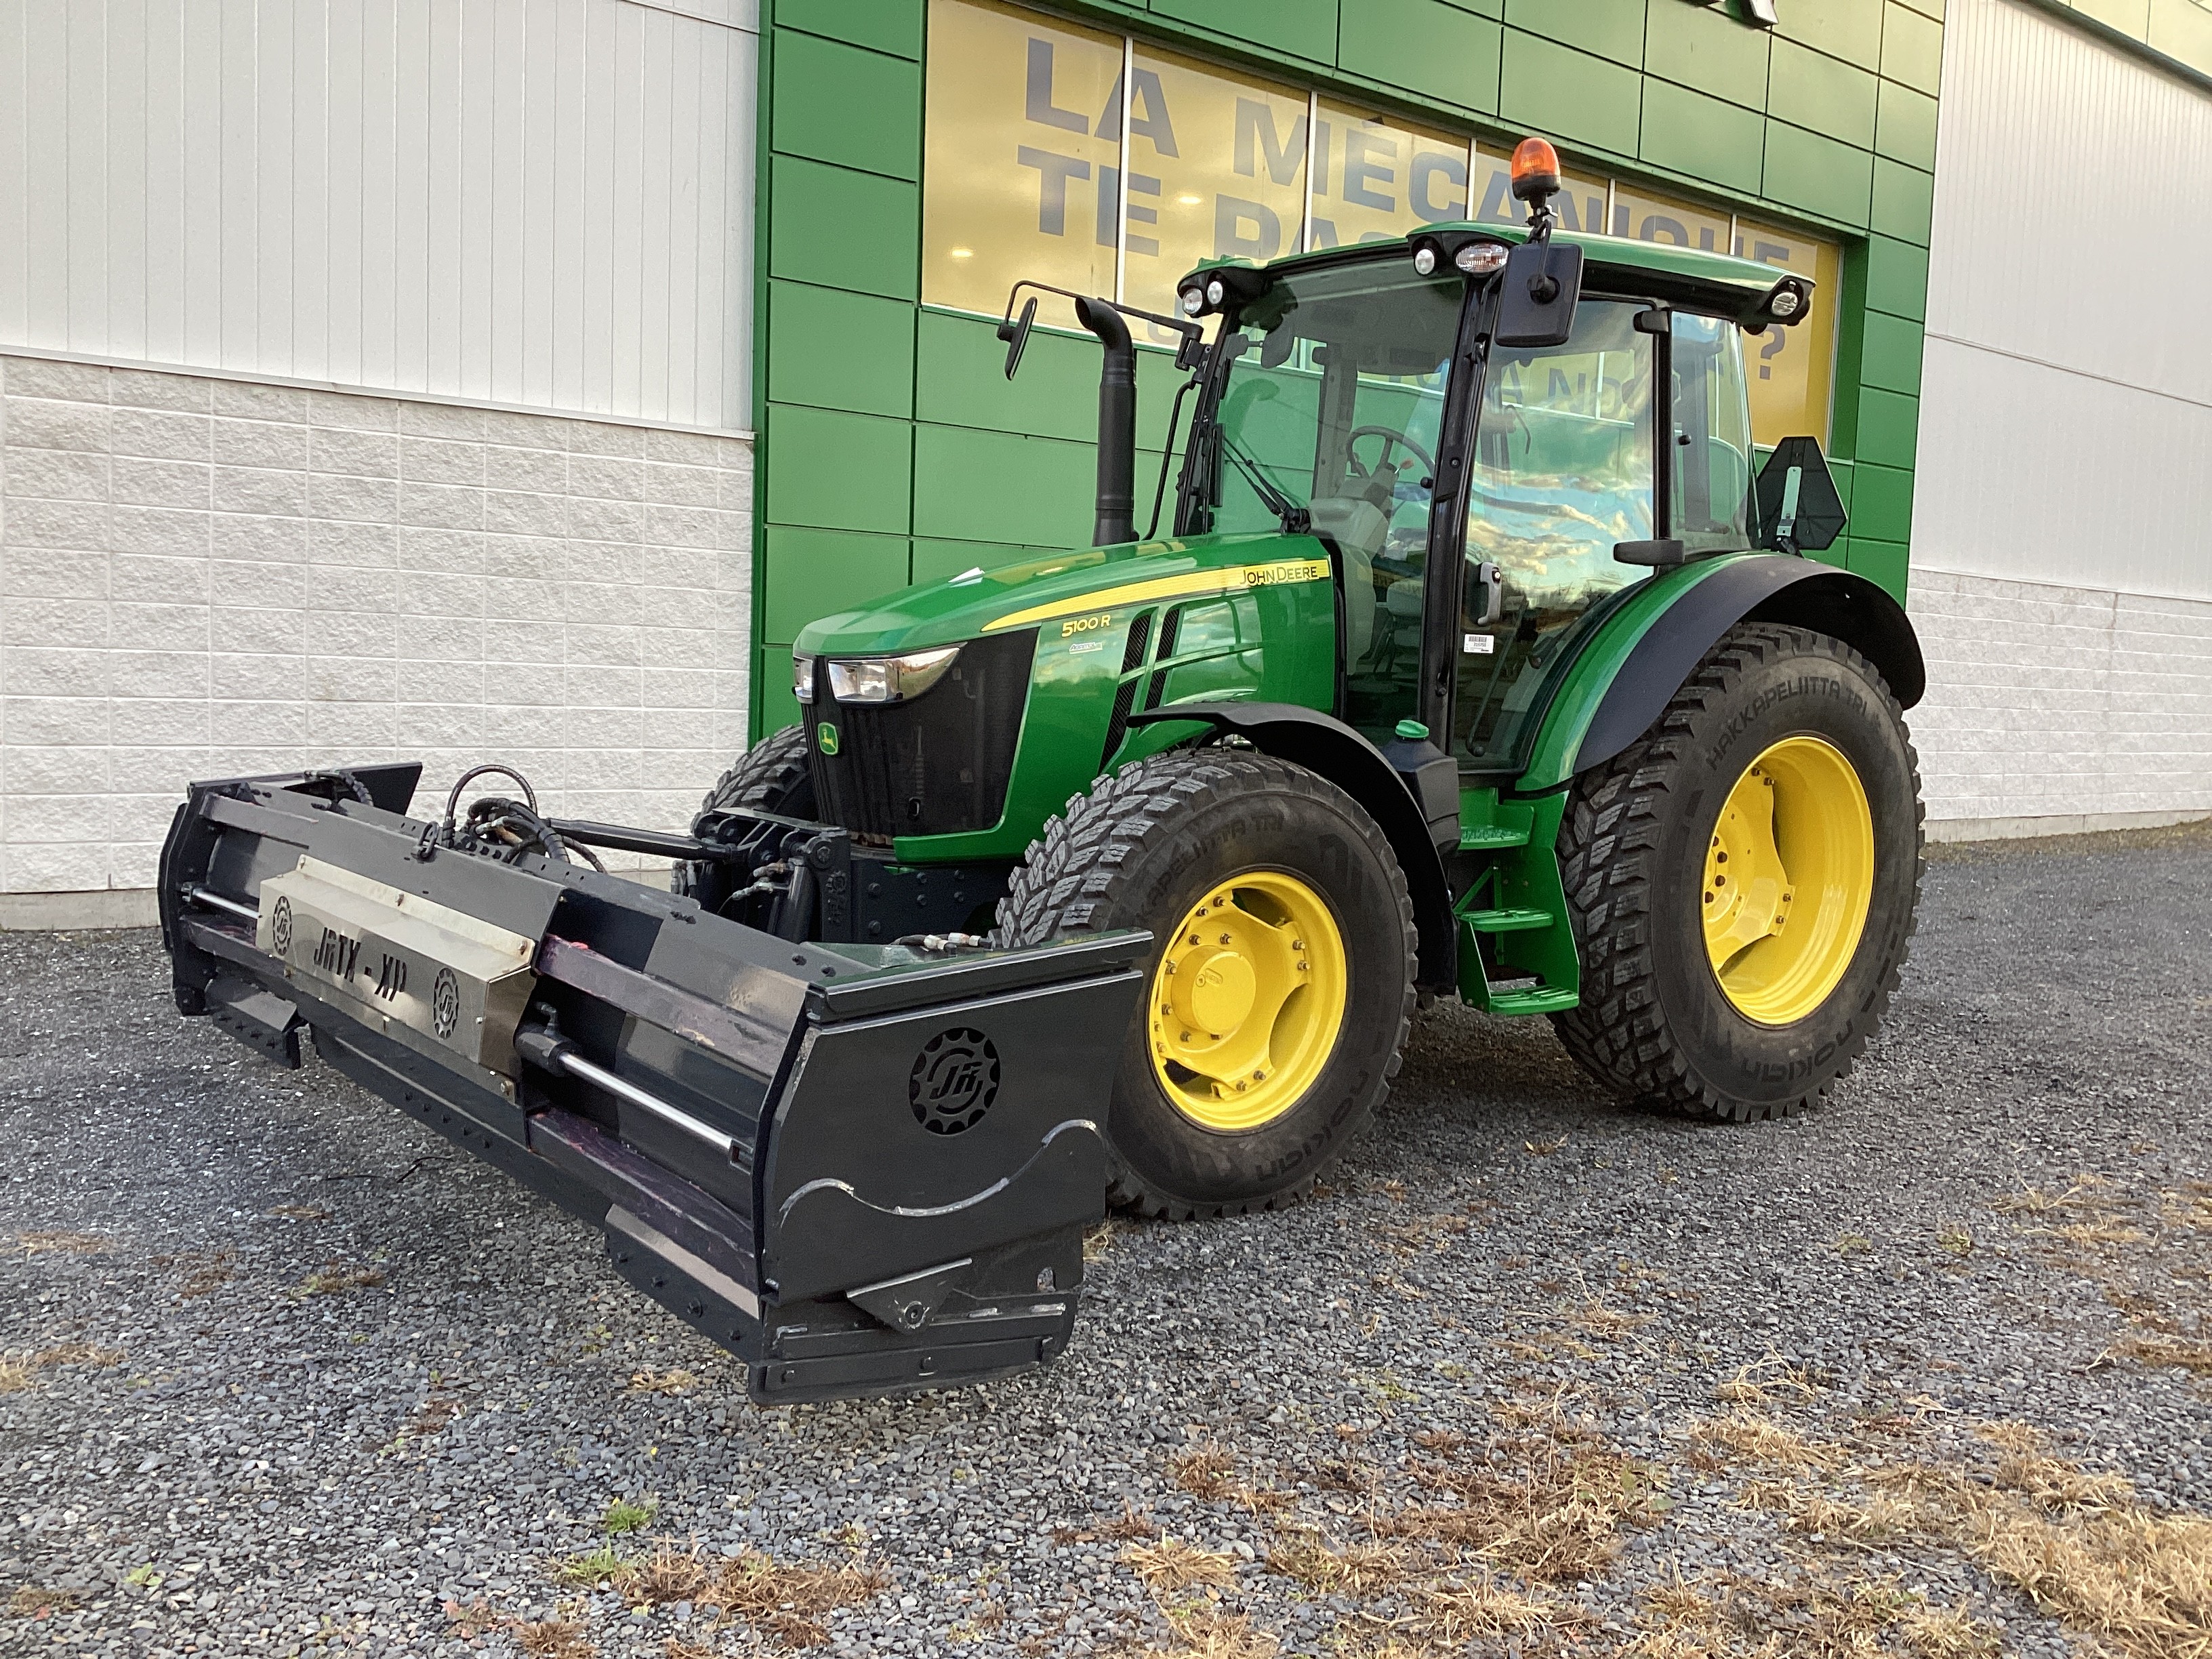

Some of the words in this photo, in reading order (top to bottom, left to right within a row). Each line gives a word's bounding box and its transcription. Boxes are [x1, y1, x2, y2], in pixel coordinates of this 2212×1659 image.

[1025, 37, 1179, 159] LA
[1017, 144, 1162, 258] TE
[1757, 323, 1786, 381] ?
[1240, 569, 1275, 585] JOHN
[1276, 566, 1318, 581] DEERE
[1061, 617, 1099, 638] 5100
[1101, 614, 1111, 628] R
[1706, 676, 1841, 771] HAKKAPELIITTA
[313, 926, 362, 983] JRTX
[374, 953, 407, 1002] XP
[928, 1061, 983, 1101] JR
